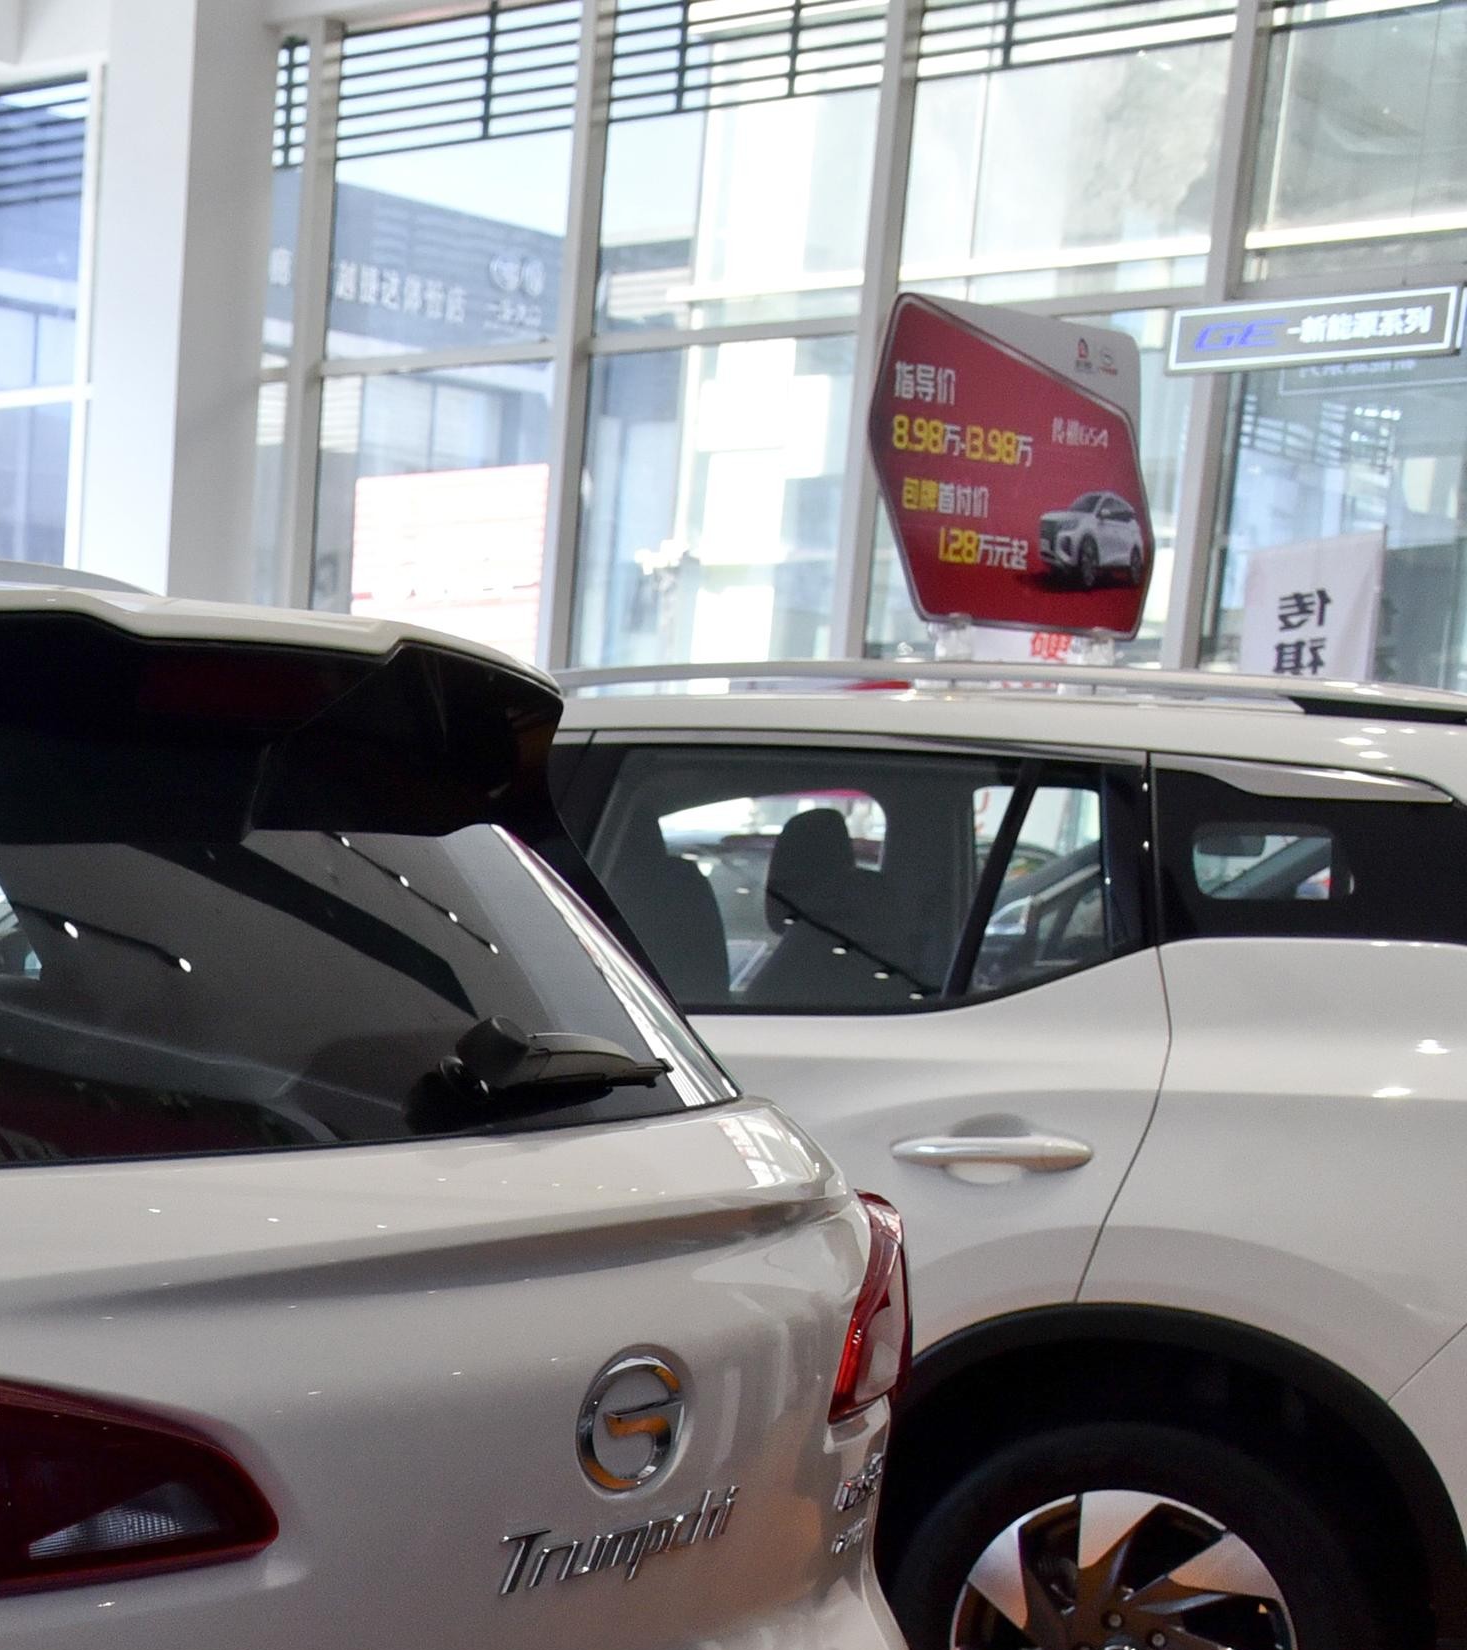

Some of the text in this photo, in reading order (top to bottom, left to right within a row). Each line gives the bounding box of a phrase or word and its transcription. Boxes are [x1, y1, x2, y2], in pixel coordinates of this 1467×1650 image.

[895, 361, 955, 406] 指导价
[501, 1485, 738, 1595] Trumpchi
